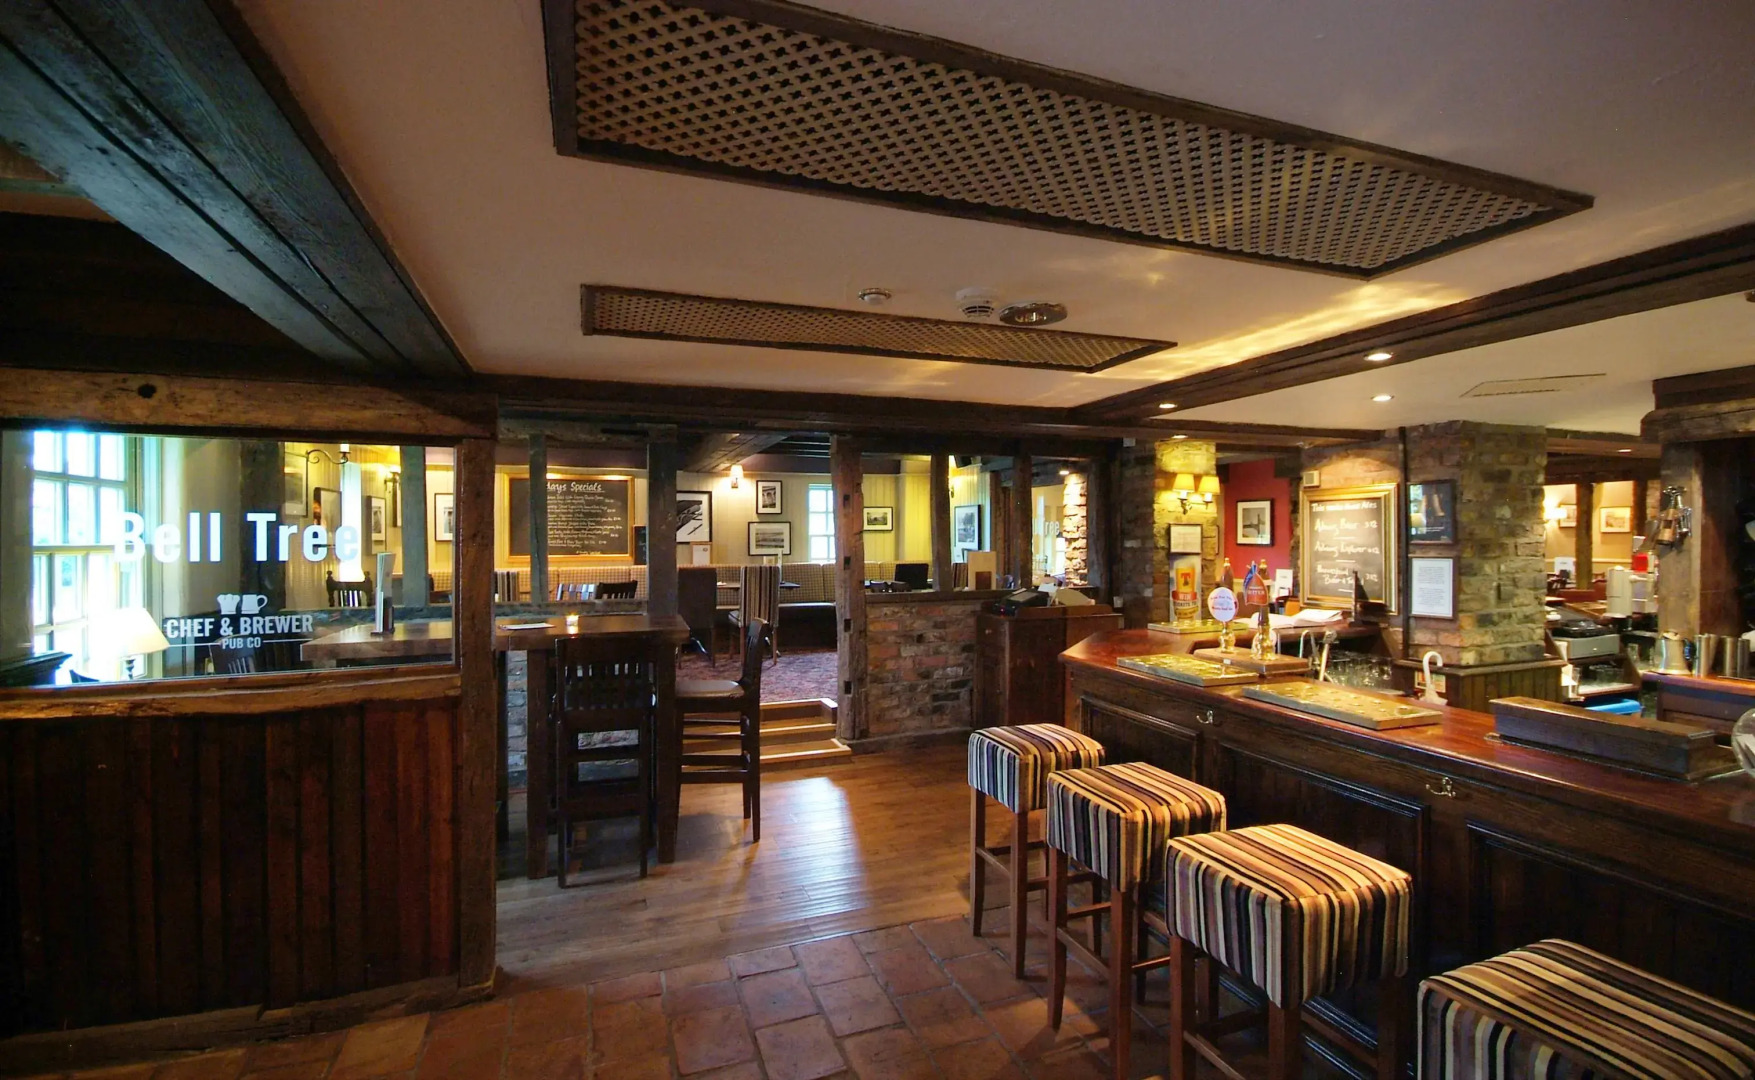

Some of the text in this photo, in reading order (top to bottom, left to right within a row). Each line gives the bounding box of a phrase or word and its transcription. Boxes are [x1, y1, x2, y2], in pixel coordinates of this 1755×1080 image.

[570, 482, 602, 493] Specials
[113, 511, 359, 563] Bell Tree
[167, 615, 313, 638] CHEF & BREWER
[222, 637, 261, 650] PUB CO
